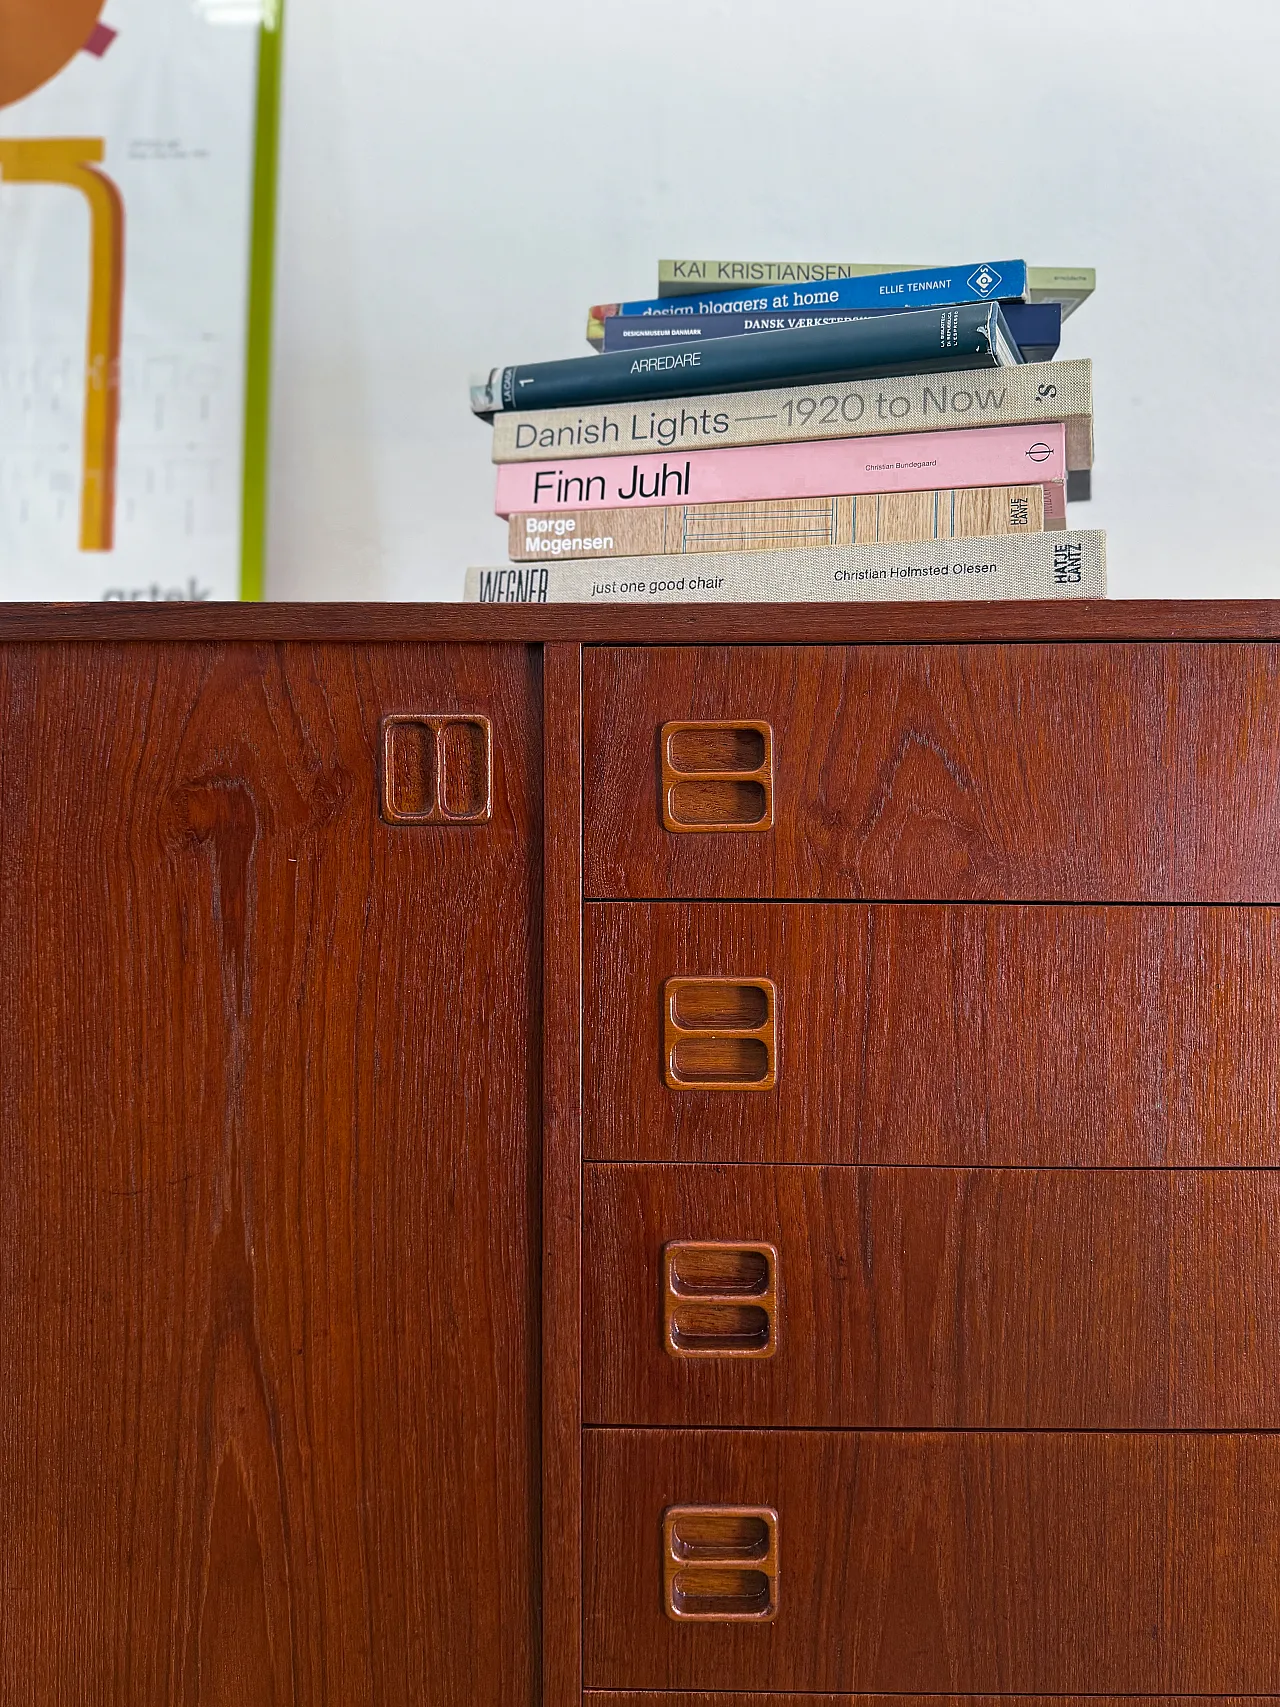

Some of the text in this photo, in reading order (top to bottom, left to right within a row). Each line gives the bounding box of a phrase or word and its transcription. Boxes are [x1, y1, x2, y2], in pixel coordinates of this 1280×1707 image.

[673, 261, 851, 281] KAI KRISTIANSEN
[879, 279, 952, 295] ELLIE TENNANT
[699, 298, 768, 314] bloggers
[772, 294, 788, 307] at
[793, 290, 839, 307] home
[623, 328, 702, 337] DESIGNMUSEUM DANMARK
[744, 319, 785, 330] DANSK
[630, 352, 702, 374] ARREDARE
[519, 378, 534, 388] 1
[516, 416, 619, 449] Danish
[632, 408, 729, 446] Lights
[782, 392, 865, 427] 1920
[877, 391, 911, 418] to
[923, 385, 1008, 415] Now
[865, 459, 937, 471] Christian Bundegaard
[533, 461, 691, 504] Finn Juhl
[1010, 498, 1020, 526] HATJE
[1019, 497, 1028, 525] CANTZ
[526, 518, 576, 536] Børge
[526, 535, 614, 554] Mogensen
[834, 561, 998, 582] Christian Holmsted Olesen
[1054, 544, 1068, 584] HATJE
[1067, 542, 1082, 583] CANTZ
[480, 568, 549, 602] WEGNER
[591, 576, 725, 598] just one good chair
